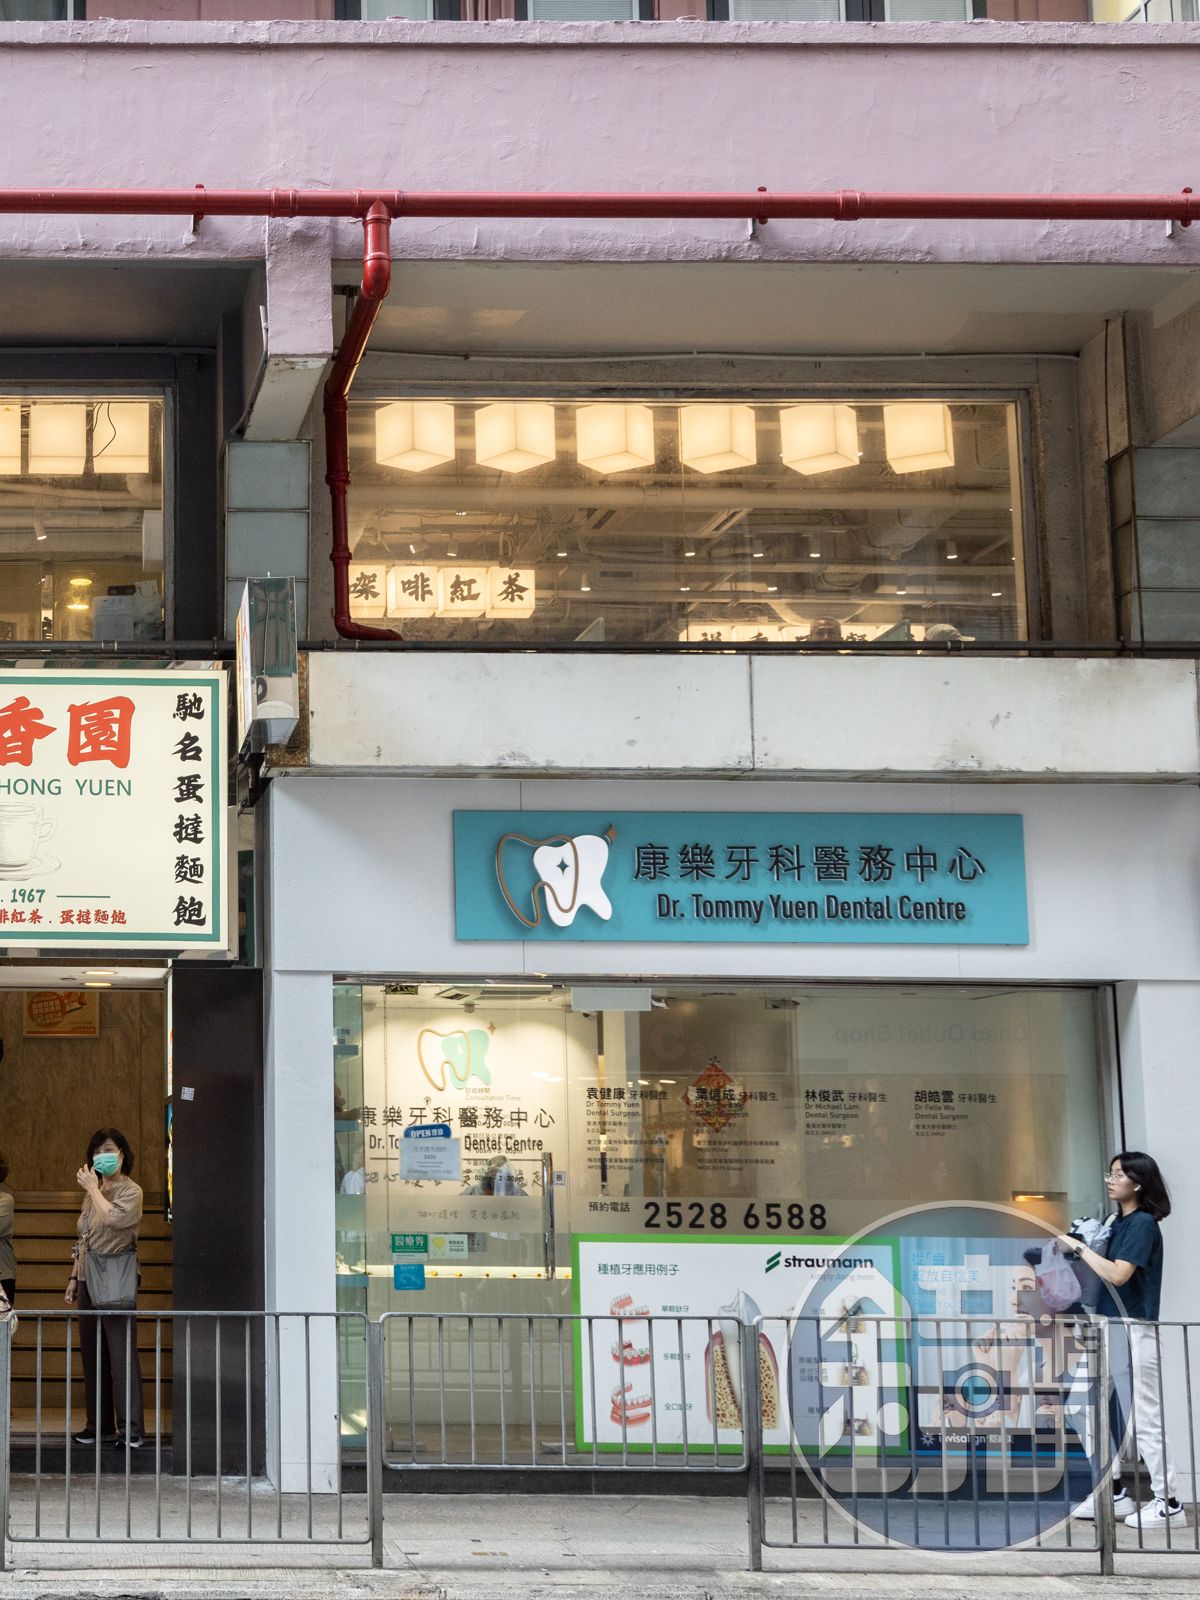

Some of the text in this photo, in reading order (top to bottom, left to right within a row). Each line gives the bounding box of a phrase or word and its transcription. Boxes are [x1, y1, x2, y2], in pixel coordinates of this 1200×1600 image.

[75, 779, 133, 797] YUEN
[633, 843, 986, 884] 康樂牙科醫務中心
[10, 888, 46, 903] 1967
[657, 894, 966, 925] Dr. Tommy Yuen Dental Centre
[586, 1087, 626, 1100] 袁健康
[805, 1089, 888, 1102] 林俊武 牙科醫生
[958, 1093, 997, 1103] 牙科醫生
[829, 1112, 859, 1120] Surgeon
[939, 1113, 969, 1121] Surgeon
[369, 1134, 385, 1149] Dr.
[464, 1135, 501, 1151] Dental
[505, 1136, 544, 1151] Centre
[588, 1201, 630, 1213] 預約電話
[643, 1202, 828, 1230] 2528 6588
[784, 1255, 874, 1269] straumann
[597, 1263, 680, 1276] 種植牙應用例子
